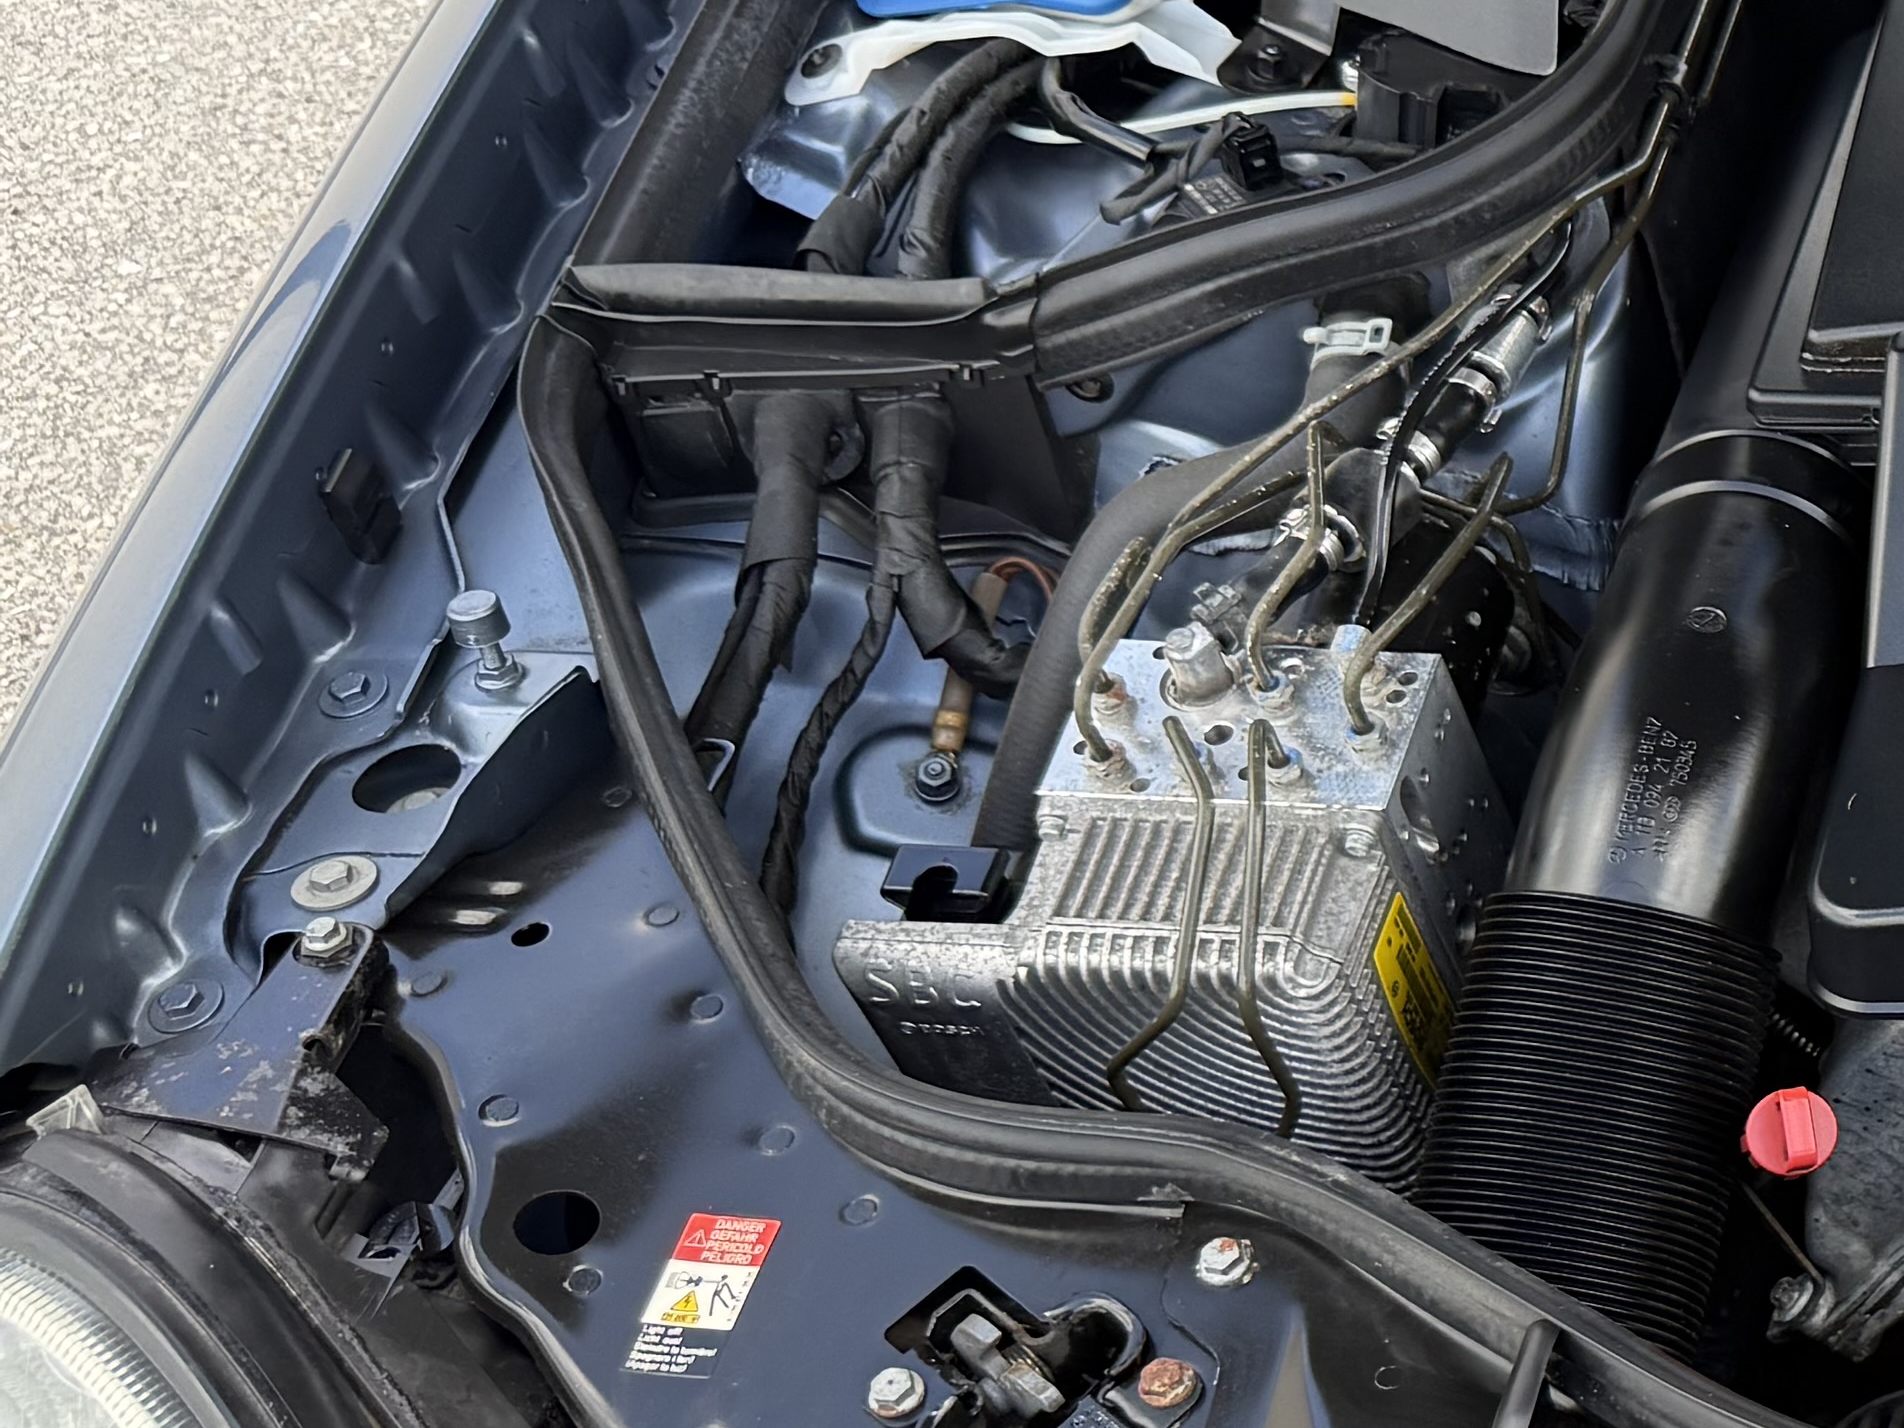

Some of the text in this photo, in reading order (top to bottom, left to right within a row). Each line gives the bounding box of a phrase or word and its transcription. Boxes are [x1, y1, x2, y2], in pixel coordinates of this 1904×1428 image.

[864, 957, 983, 1008] SBC
[715, 1218, 767, 1234] DANGER
[710, 1229, 759, 1244] GEFAHR
[705, 1240, 765, 1255] PERICOLO
[700, 1251, 753, 1265] PELIGRO
